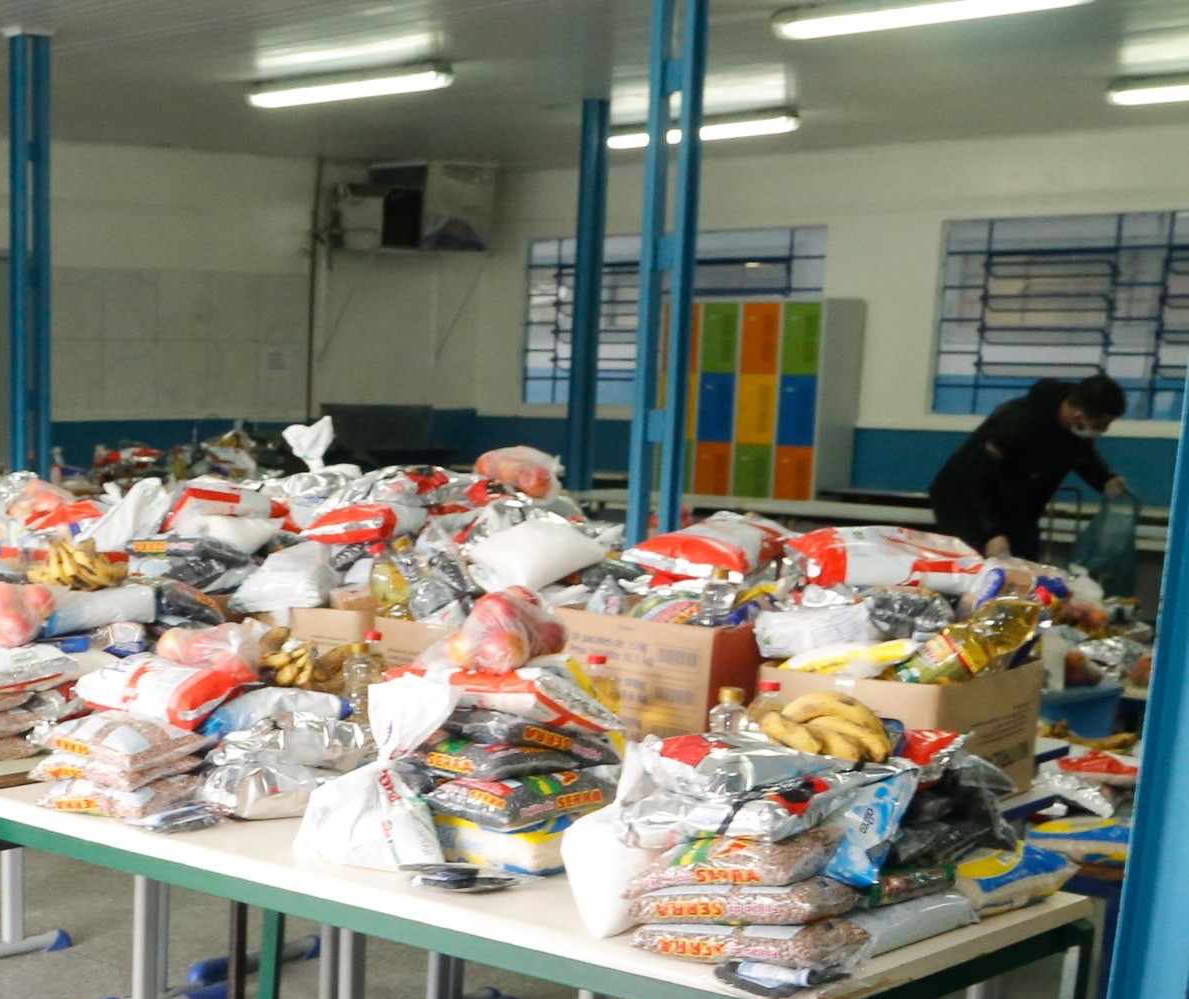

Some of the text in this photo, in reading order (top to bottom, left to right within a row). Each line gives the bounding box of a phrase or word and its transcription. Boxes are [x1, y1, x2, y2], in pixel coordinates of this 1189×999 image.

[556, 788, 604, 811] SERRA
[693, 867, 762, 884] SERRA
[655, 901, 729, 917] SERRA
